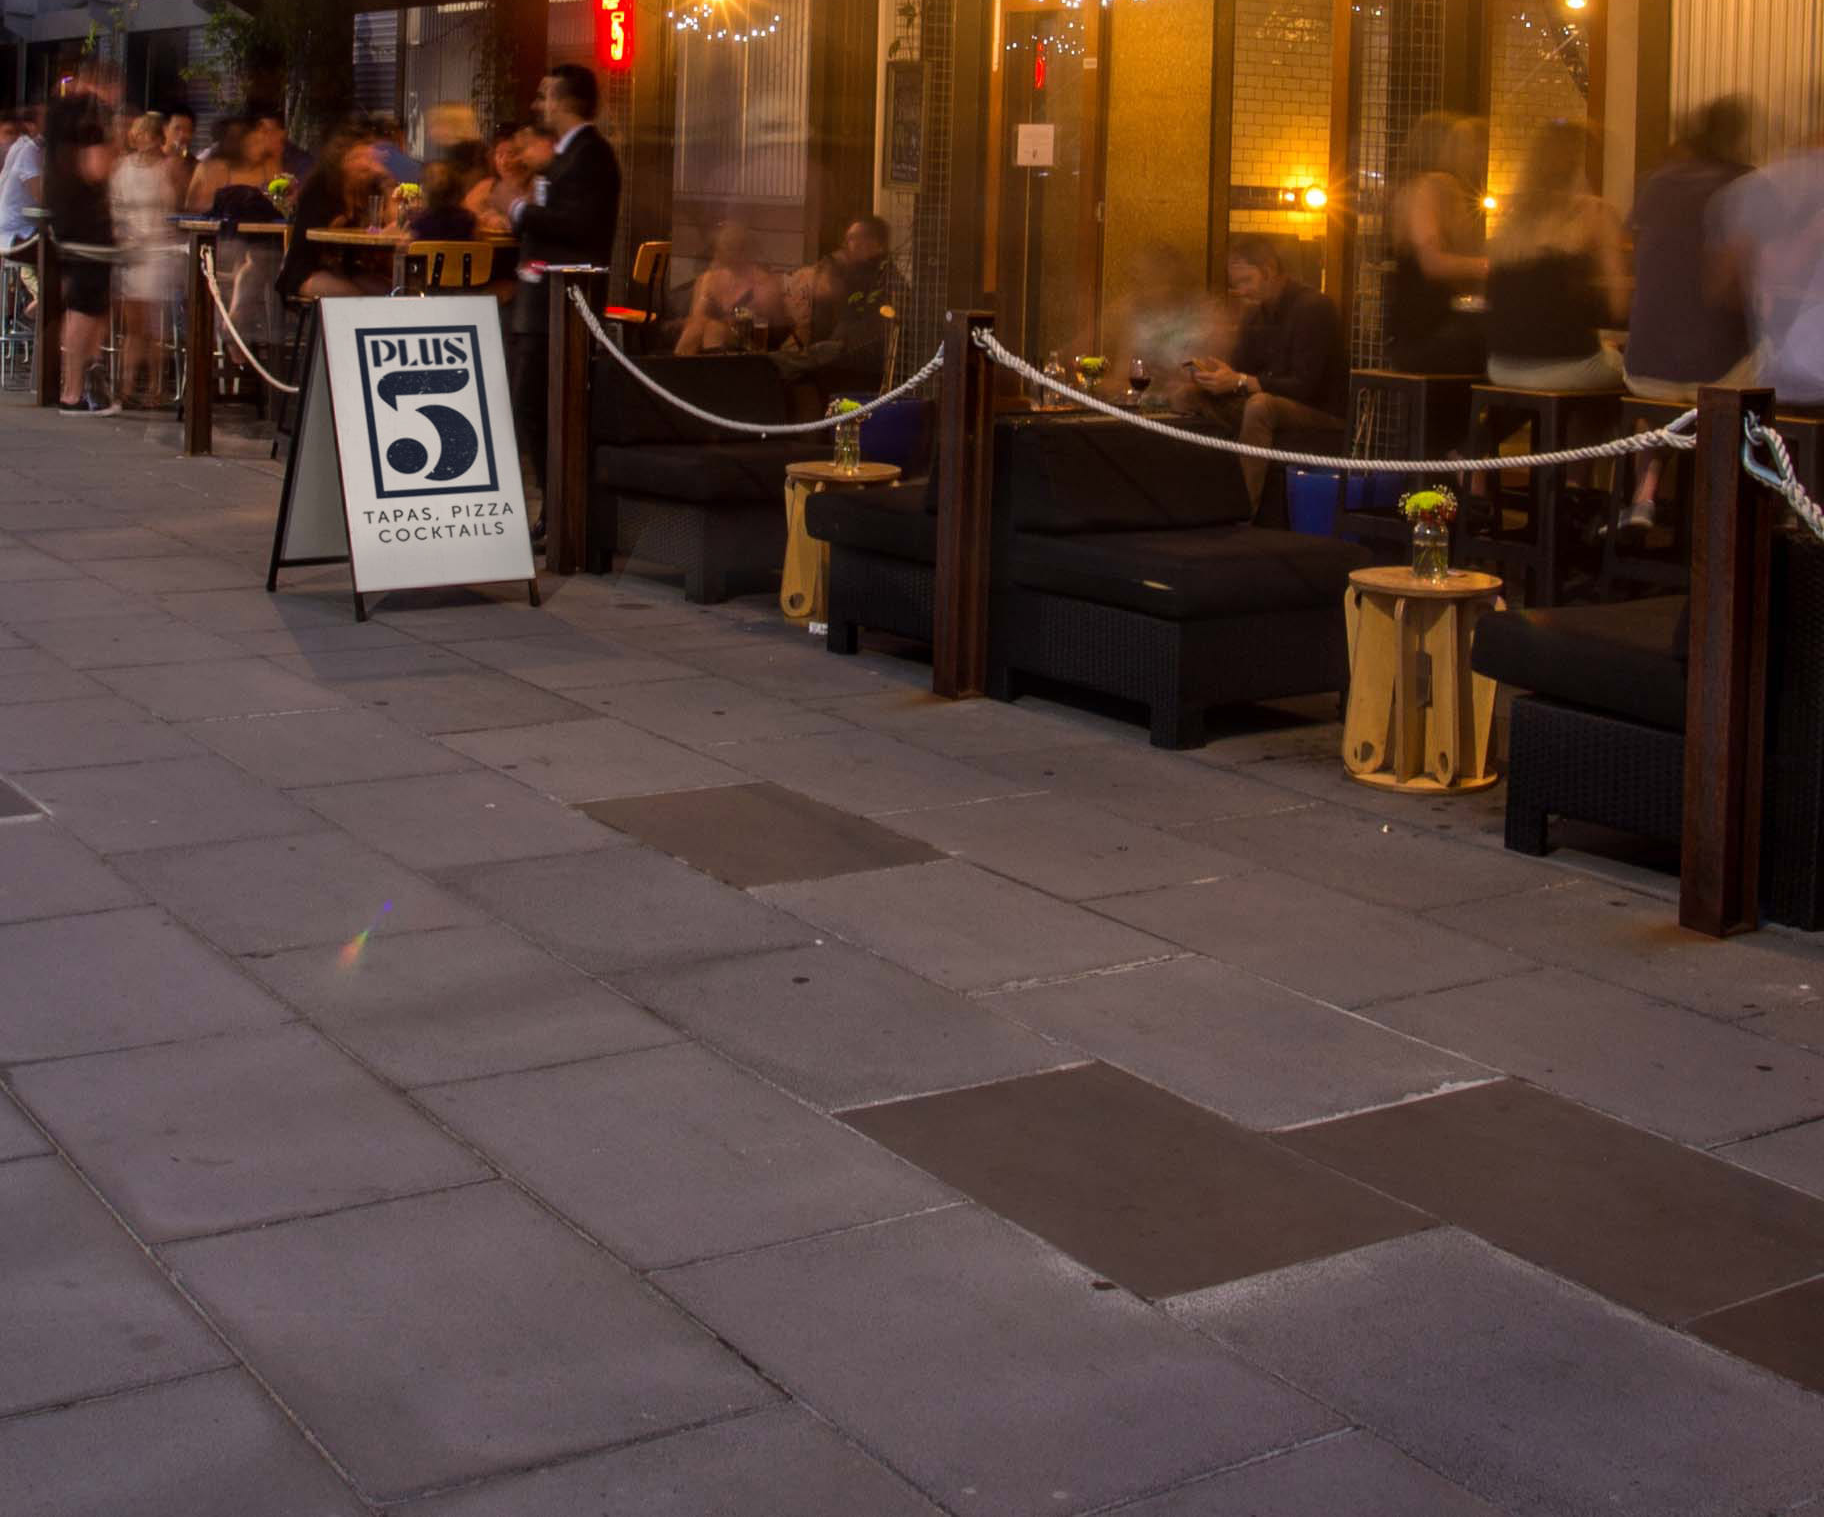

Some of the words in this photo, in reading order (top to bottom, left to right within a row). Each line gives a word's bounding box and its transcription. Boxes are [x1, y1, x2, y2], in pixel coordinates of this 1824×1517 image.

[370, 336, 469, 368] PLUS
[377, 368, 479, 481] 5
[363, 506, 440, 525] TAPAS,
[451, 501, 514, 518] PIZZA
[378, 521, 506, 544] COCKTAILS
